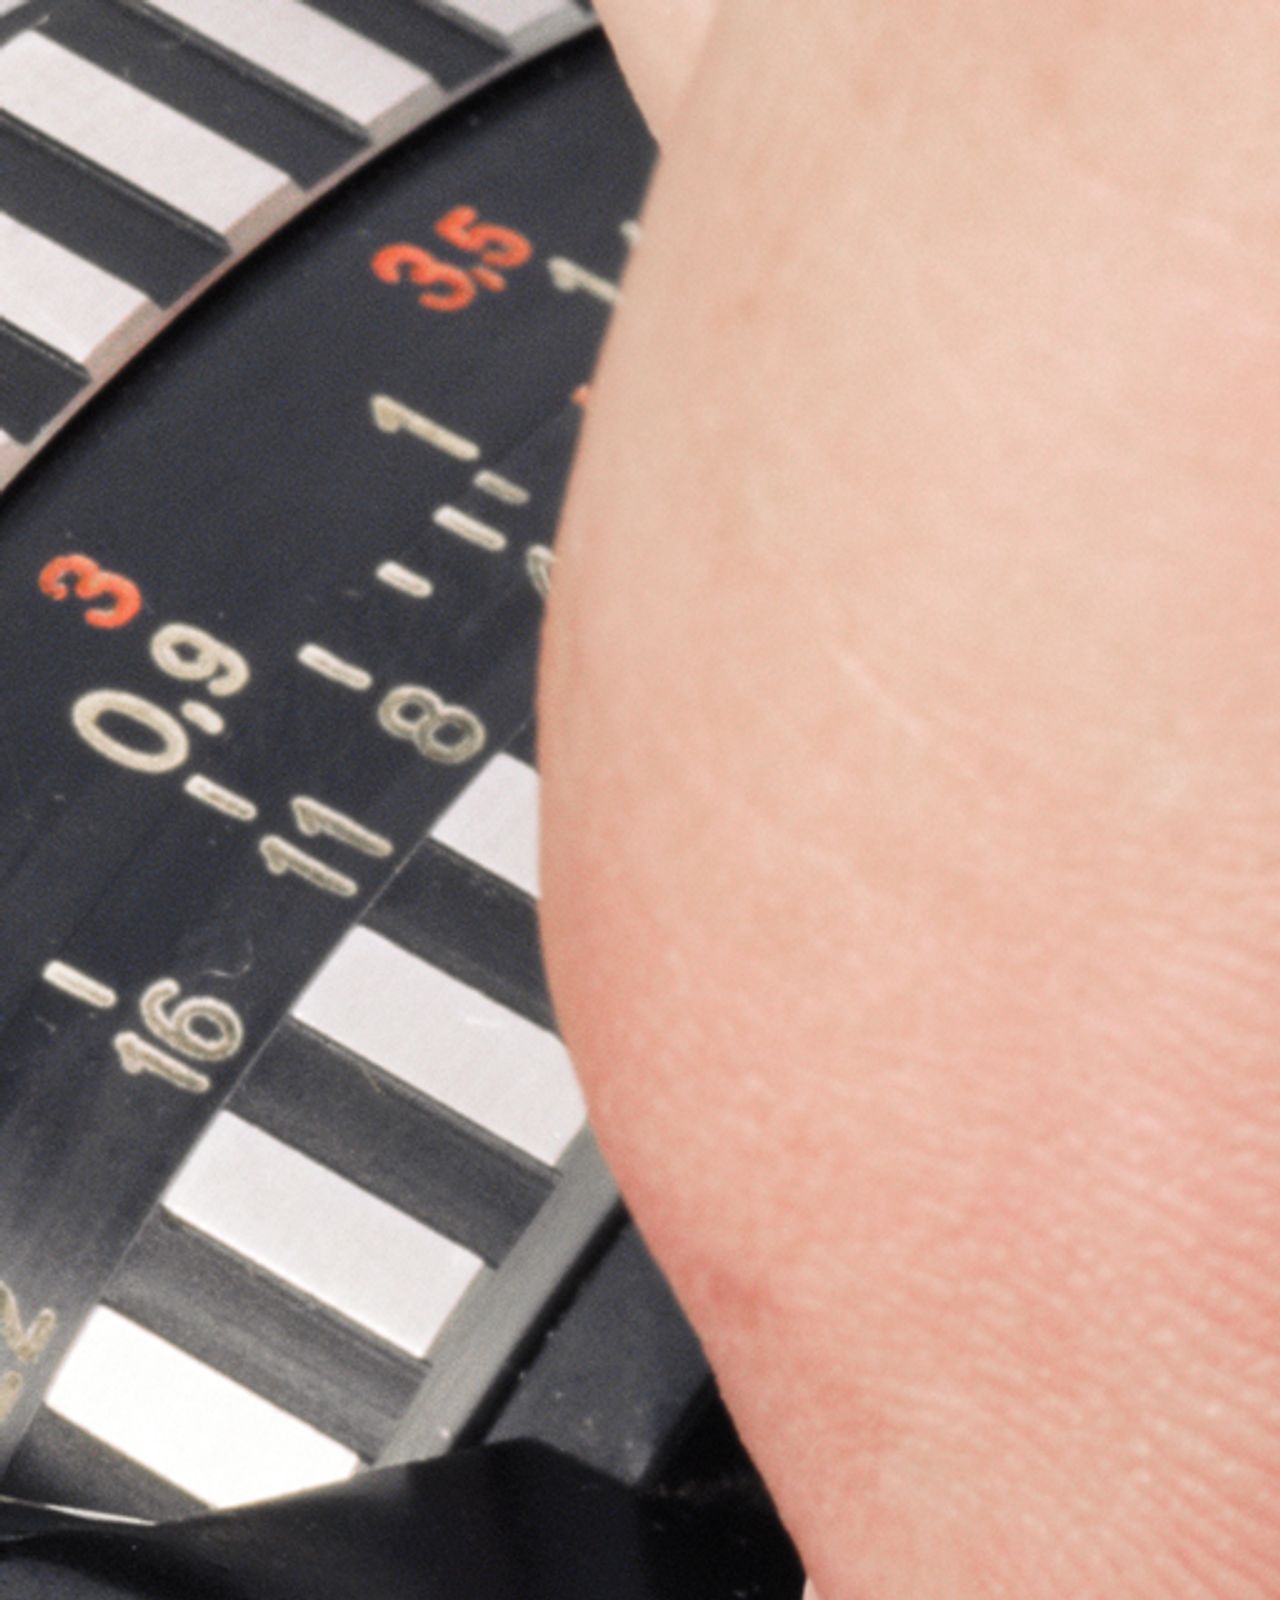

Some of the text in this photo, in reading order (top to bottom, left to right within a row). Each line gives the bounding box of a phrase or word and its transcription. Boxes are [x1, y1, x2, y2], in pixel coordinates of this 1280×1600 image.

[371, 205, 533, 313] 3,5
[371, 394, 481, 461] 1
[38, 553, 142, 630] 3
[377, 684, 486, 763] 8
[259, 796, 393, 897] 11
[113, 978, 244, 1093] 16
